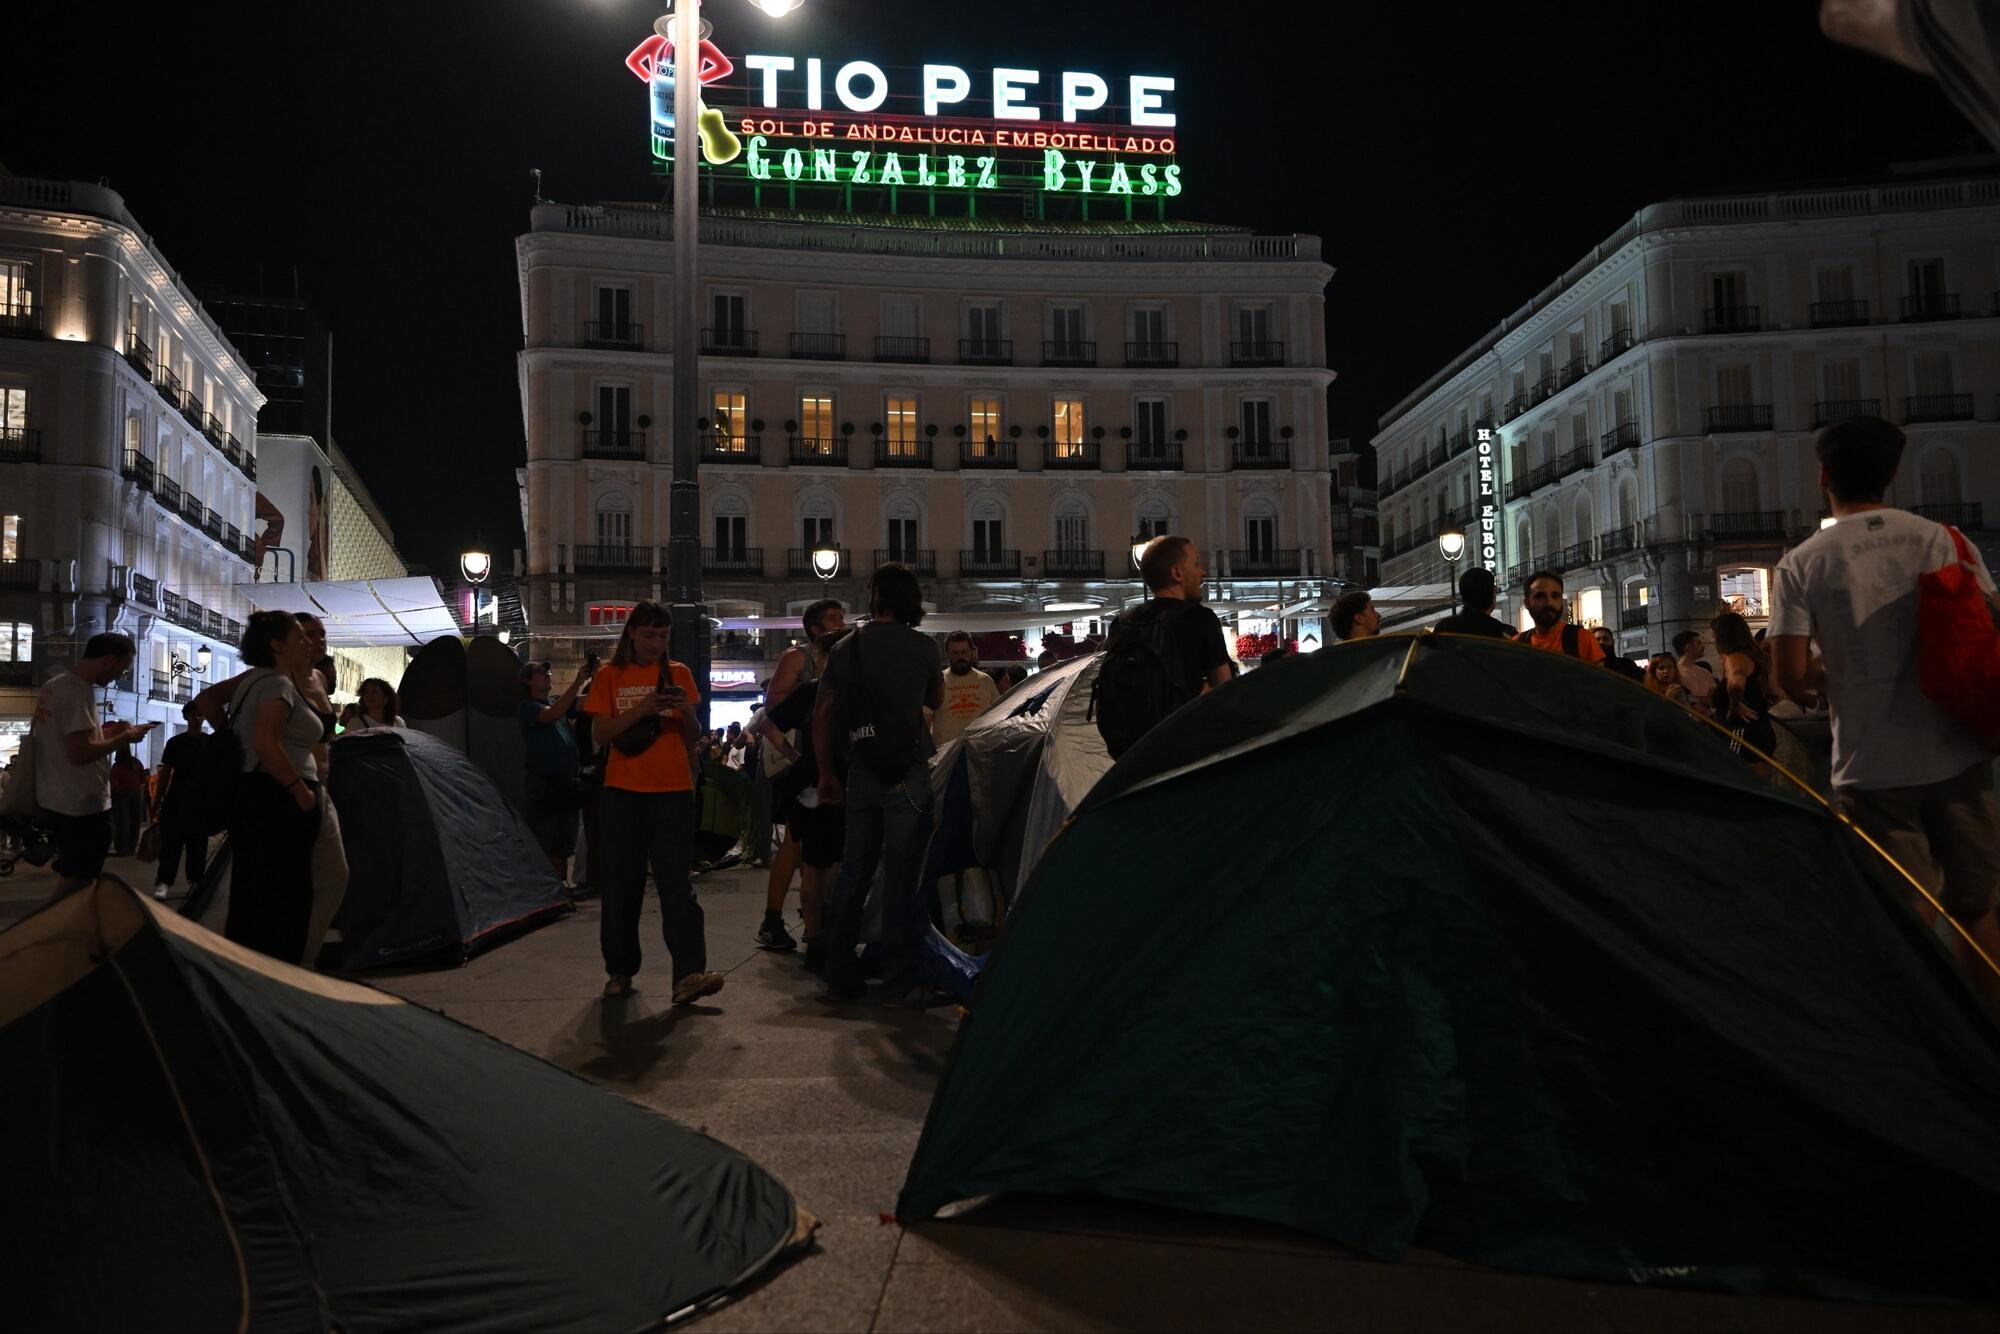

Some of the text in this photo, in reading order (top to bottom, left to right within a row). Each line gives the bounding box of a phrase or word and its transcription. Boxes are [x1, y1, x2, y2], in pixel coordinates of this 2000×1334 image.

[745, 54, 1176, 127] TIO PEPE
[741, 119, 1175, 153] SOL DE ANDALUCIA EMBOTELLADO
[747, 135, 1181, 196] GONZALEZ BYASS
[1477, 429, 1496, 571] HOTEL EUROP
